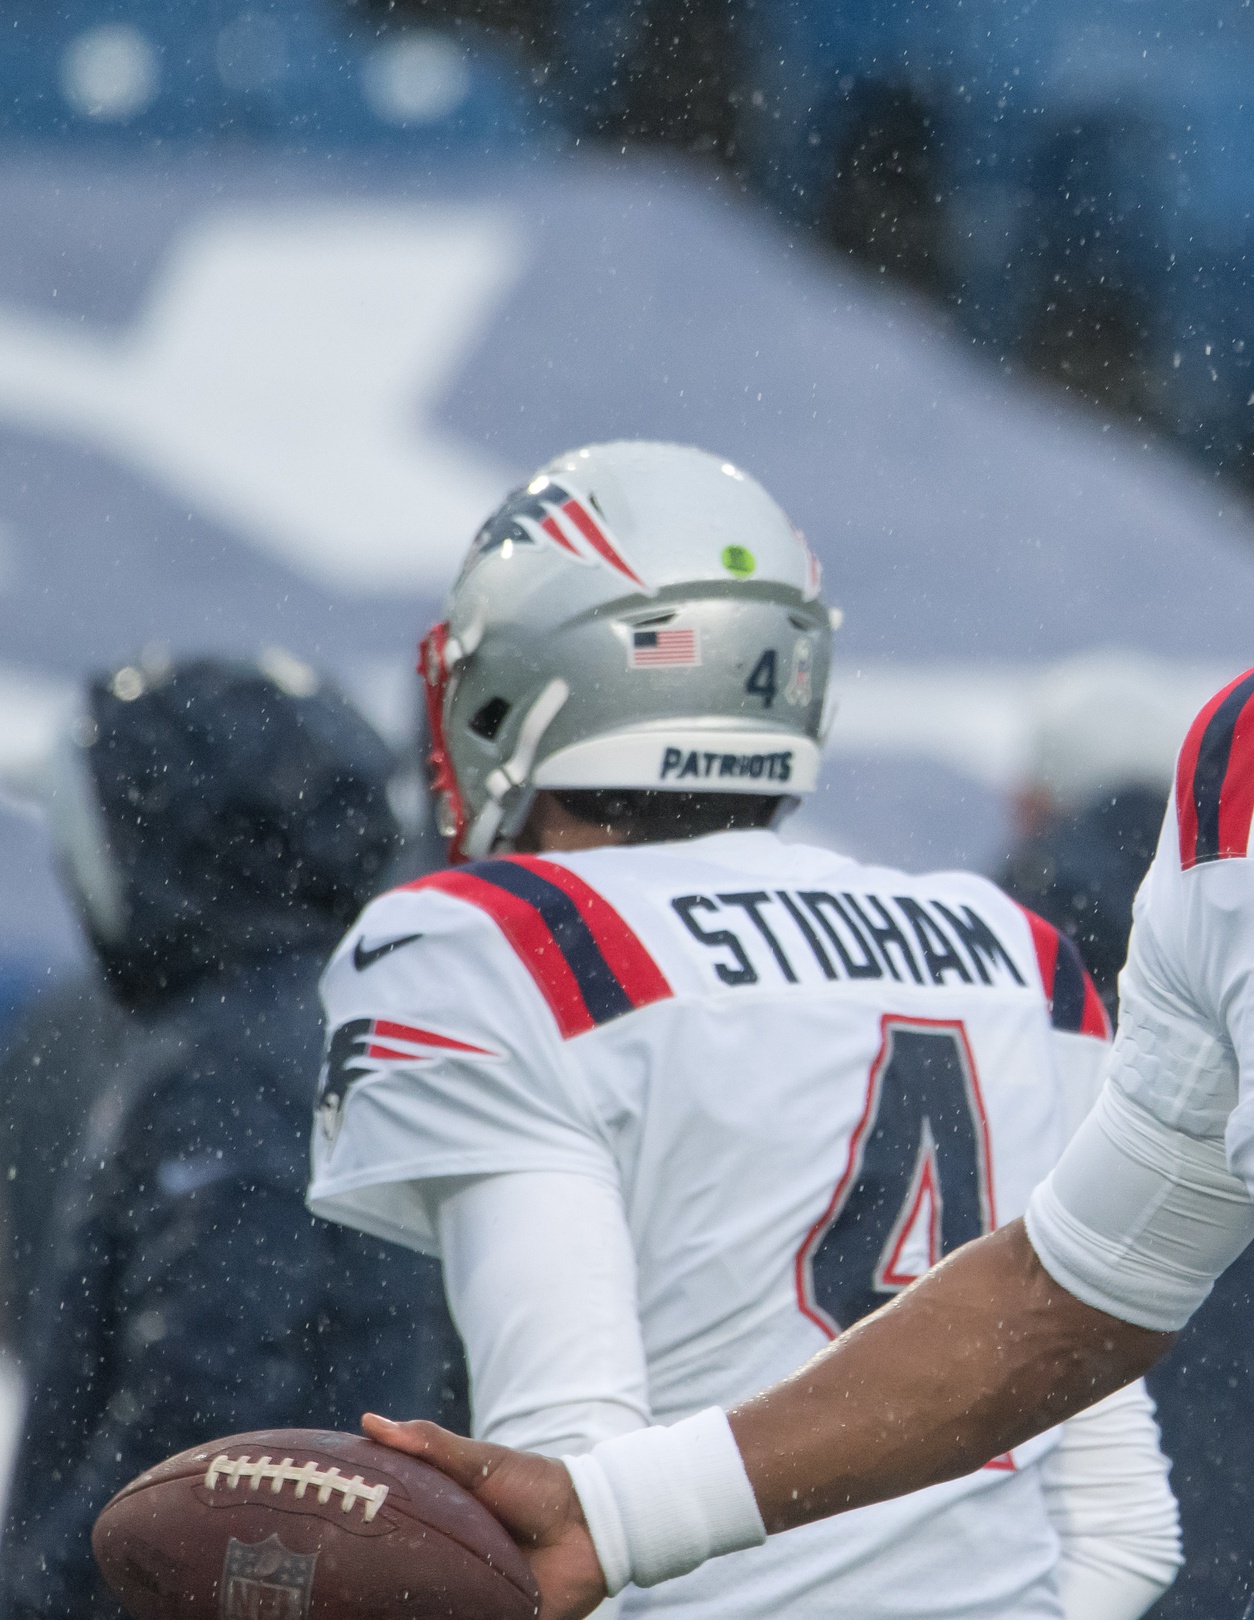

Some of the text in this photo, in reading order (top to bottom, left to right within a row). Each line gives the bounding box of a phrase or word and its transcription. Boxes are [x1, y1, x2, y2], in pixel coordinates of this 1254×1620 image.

[745, 648, 776, 709] 4
[661, 747, 793, 783] PATRIOTS
[671, 890, 1028, 987] STIDHAM
[796, 1013, 998, 1342] 4
